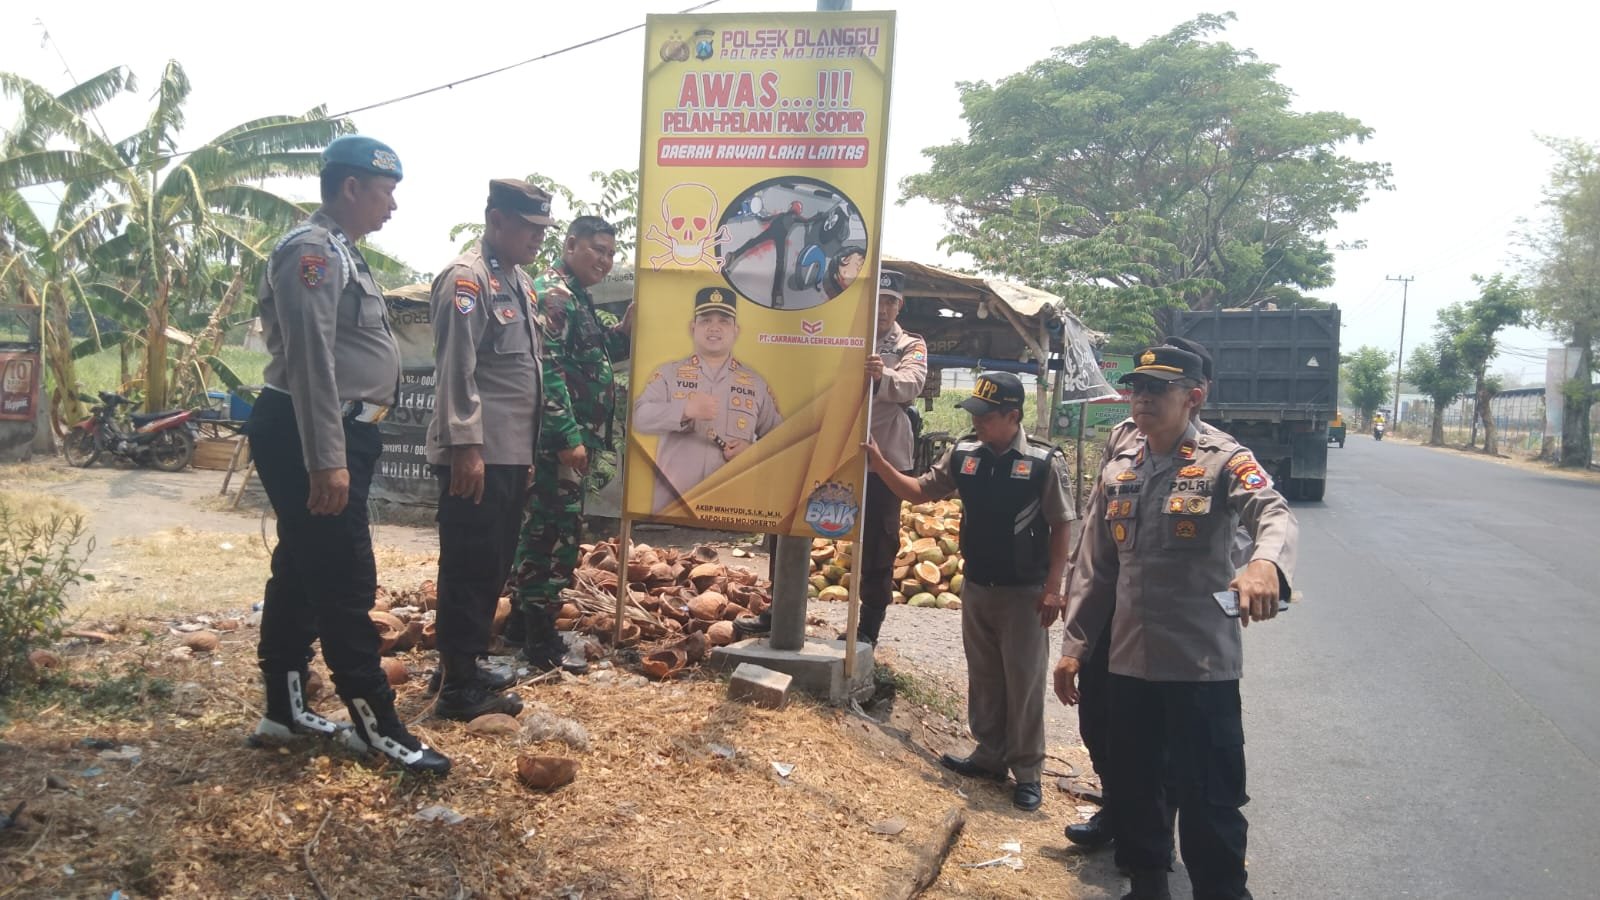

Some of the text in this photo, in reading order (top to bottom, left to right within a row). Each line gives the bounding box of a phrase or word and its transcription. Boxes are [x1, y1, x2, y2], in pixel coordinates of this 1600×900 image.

[721, 26, 879, 48] POLSEK DLANGGU
[719, 45, 877, 60] POLRES MOJOKERTO
[662, 110, 865, 133] PELAN-PELAN PAK SOPIR
[660, 143, 865, 160] DAERAH RAWAN LAKA LANTAS
[771, 335, 809, 345] CAKRAWALA
[810, 336, 850, 346] CEMERLANG
[850, 337, 865, 347] BOX
[676, 381, 698, 389] YUDI
[730, 386, 756, 397] POLRI
[400, 391, 436, 410] ORPI
[382, 461, 438, 481] ORPION
[1169, 479, 1210, 493] POLRI
[695, 504, 714, 512] AKBP
[805, 501, 859, 526] BAIK
[700, 514, 777, 528] KAPOLRES MOJOKERTO
